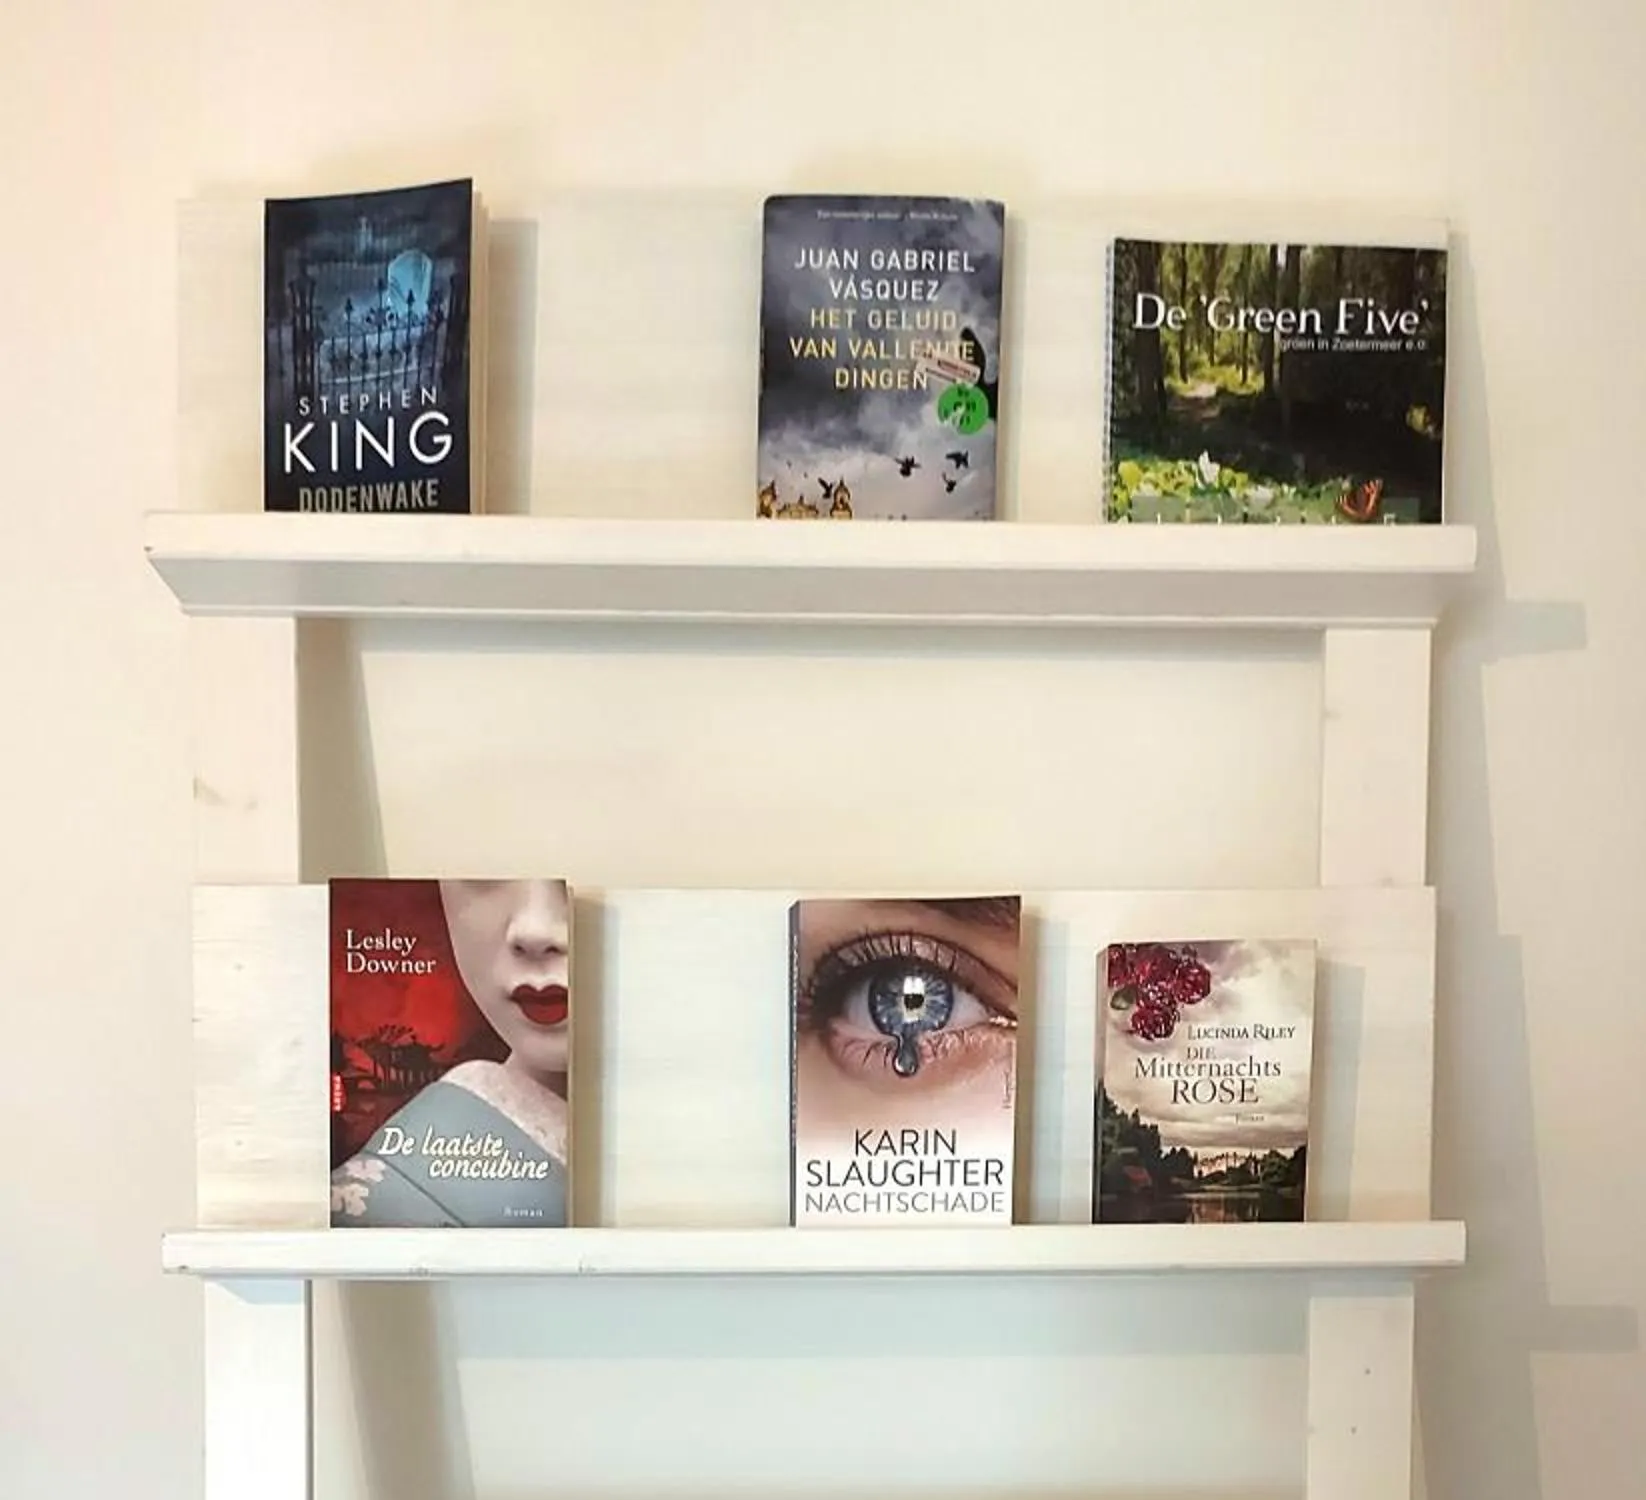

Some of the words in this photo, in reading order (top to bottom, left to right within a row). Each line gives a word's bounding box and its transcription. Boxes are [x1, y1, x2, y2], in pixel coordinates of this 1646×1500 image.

[794, 249, 858, 271] JUAN
[871, 250, 975, 272] GABRIEL
[829, 274, 939, 300] VÁSQUEZ
[810, 309, 856, 329] HET
[868, 310, 957, 330] GELUID
[1133, 292, 1187, 331] De
[789, 337, 836, 359] VAN
[1318, 338, 1328, 350] in
[835, 368, 927, 390] DINGEN
[300, 386, 437, 415] STEPHEN
[284, 411, 452, 473] KING
[300, 479, 439, 513] DODENWAKE
[346, 928, 416, 956] Lesley
[346, 952, 436, 974] Downer
[1187, 1024, 1249, 1041] LUCINDA
[1253, 1023, 1296, 1041] RILEY
[1187, 1047, 1214, 1060] DIE
[1135, 1056, 1281, 1079] Mitternachts
[1171, 1078, 1259, 1105] ROSE
[379, 1127, 415, 1156] De
[423, 1126, 504, 1155] laatste
[854, 1129, 956, 1156] KARIN
[429, 1150, 549, 1180] concubine
[806, 1159, 1005, 1187] SLAUGHTER
[805, 1191, 1005, 1214] NACHTSCHADE
